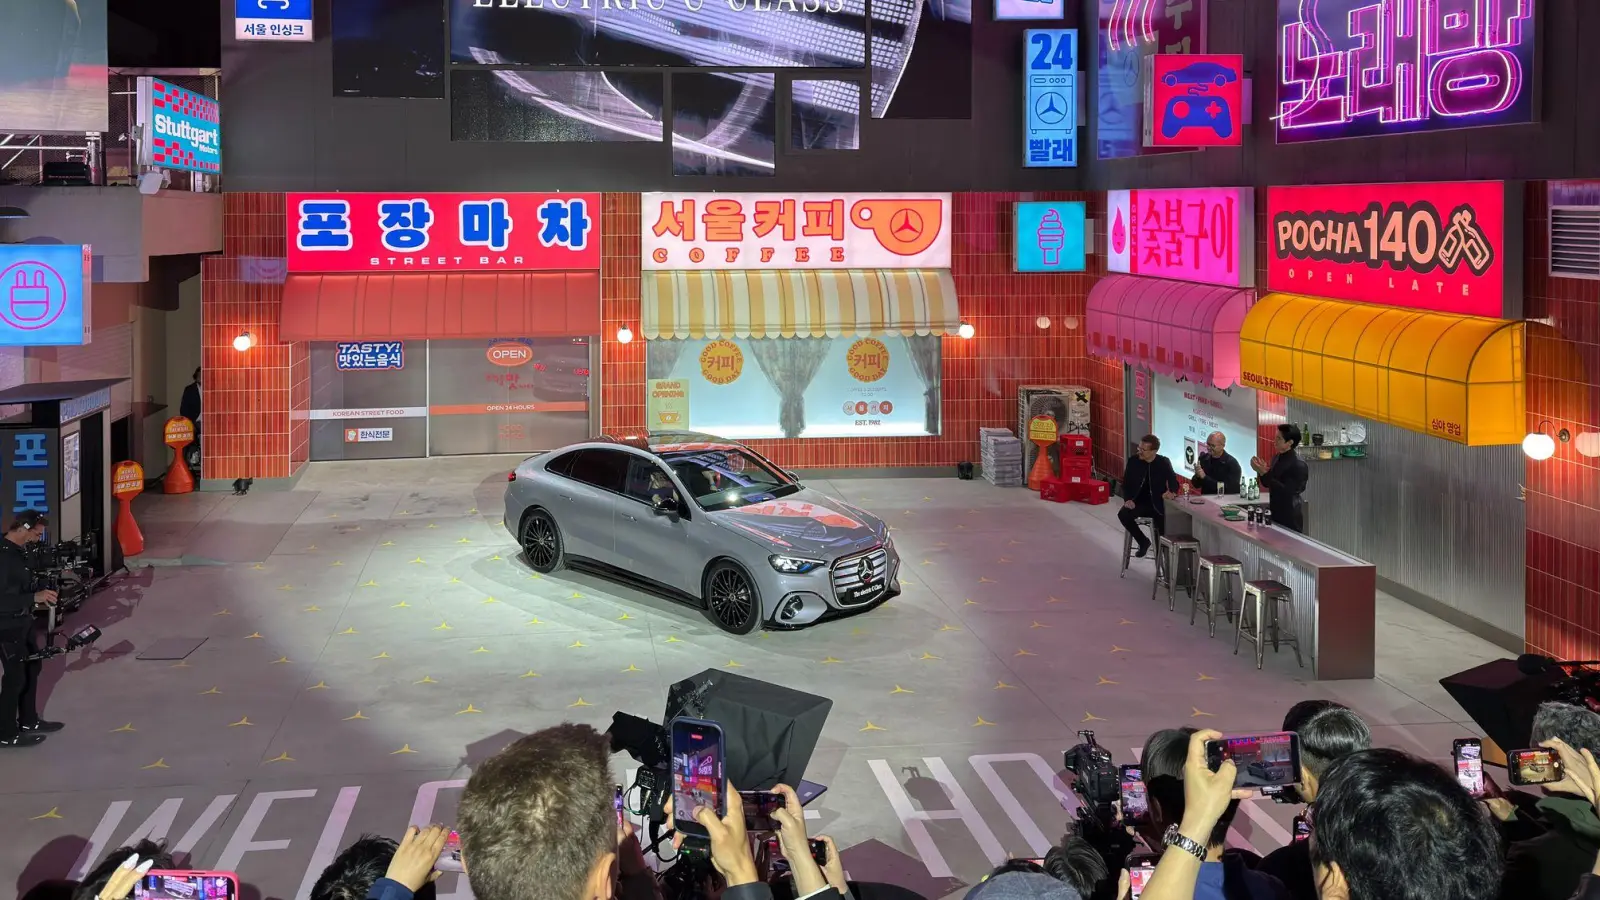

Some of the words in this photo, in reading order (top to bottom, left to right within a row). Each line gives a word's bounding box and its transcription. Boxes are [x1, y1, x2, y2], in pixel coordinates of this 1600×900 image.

[244, 23, 266, 35] 서울
[270, 24, 304, 36] 인싱크
[1031, 34, 1073, 70] 24
[155, 113, 218, 147] Stuttgart
[199, 143, 218, 155] Motors
[1029, 138, 1073, 162] 빨래
[297, 198, 591, 252] 포장마차
[652, 199, 845, 242] 서울커피
[1142, 196, 1234, 273] 숯불구이
[1278, 218, 1363, 255] POCHA
[1363, 209, 1437, 265] 140
[370, 257, 463, 265] STREET
[480, 256, 524, 265] BAR
[652, 247, 845, 263] COFFEE
[1289, 268, 1353, 285] OPEN
[1388, 277, 1469, 297] LATE
[339, 343, 401, 354] TASTY!
[492, 350, 527, 359] OPEN
[700, 342, 717, 363] GOOD
[339, 353, 401, 367] 맛있는음식
[707, 355, 735, 371] 커피
[854, 353, 881, 369] 커피
[703, 369, 724, 384] GOOD
[1243, 371, 1269, 387] SEOUL'S
[1269, 377, 1293, 392] FINEST
[360, 430, 390, 439] 한식전문
[1432, 418, 1446, 433] 심야
[1447, 422, 1461, 436] 영업
